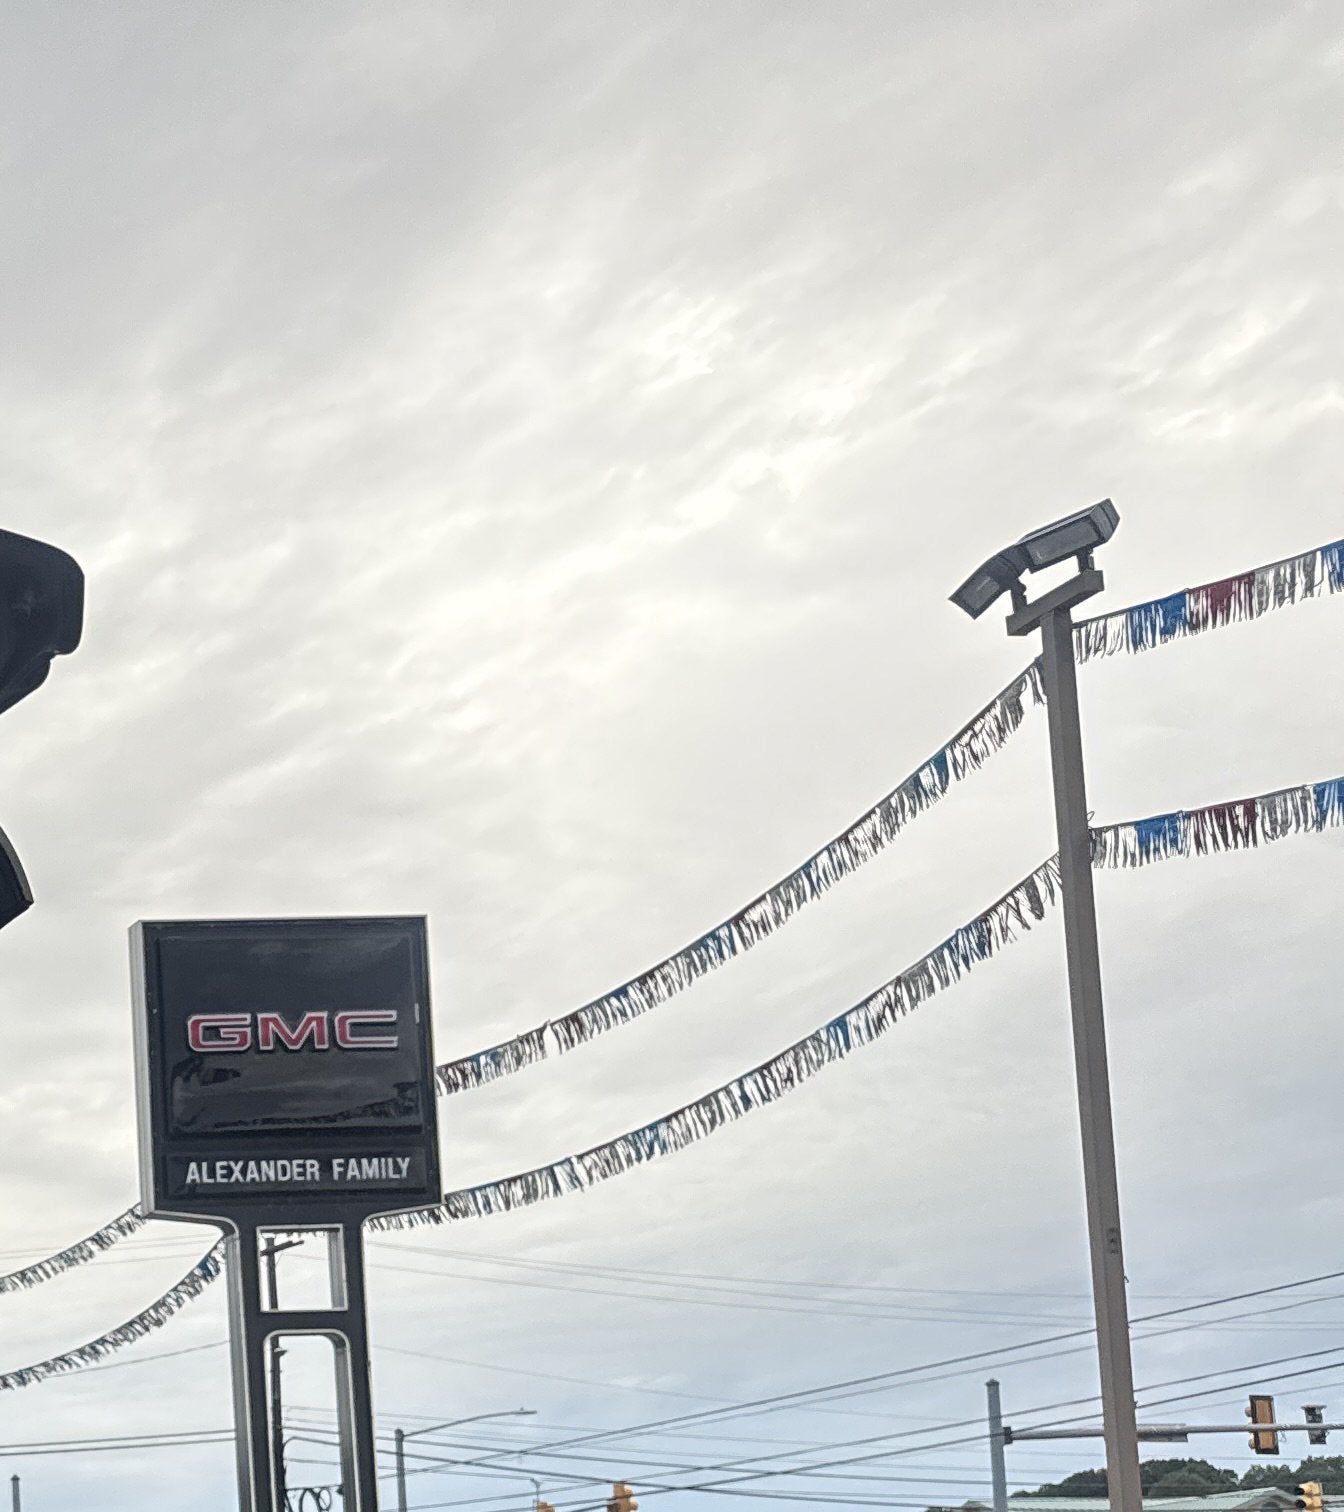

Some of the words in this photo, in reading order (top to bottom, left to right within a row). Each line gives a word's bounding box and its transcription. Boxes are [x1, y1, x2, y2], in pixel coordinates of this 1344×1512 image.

[187, 1009, 399, 1052] GMC
[185, 1159, 321, 1185] ALEXANDER
[332, 1156, 411, 1182] FAMILY
